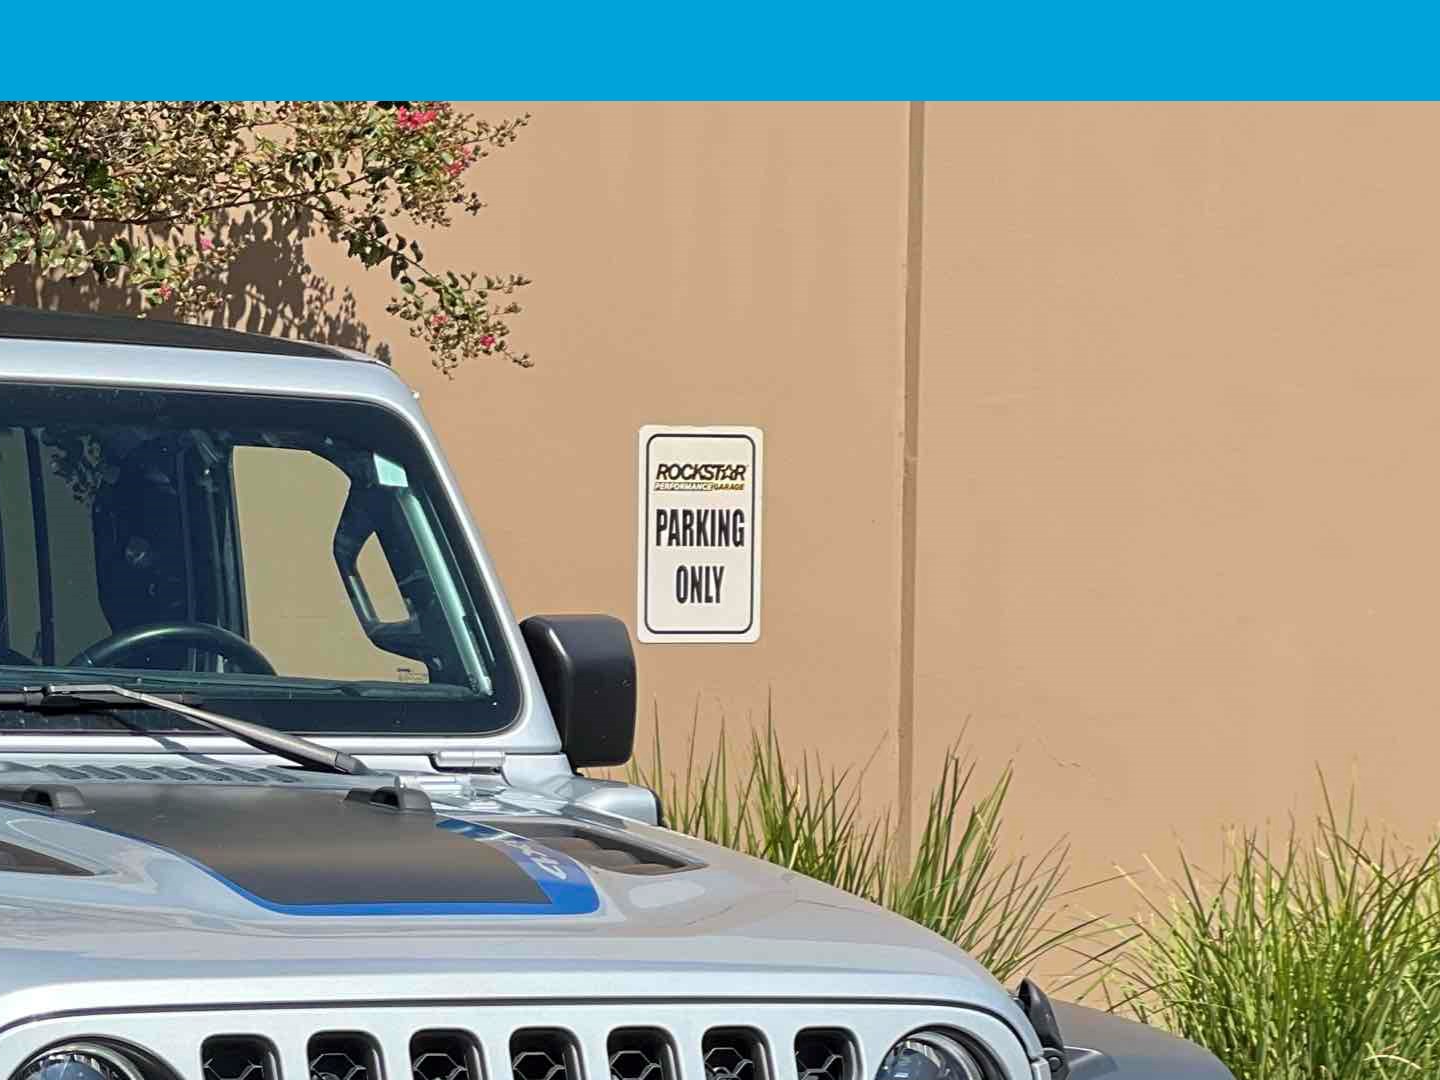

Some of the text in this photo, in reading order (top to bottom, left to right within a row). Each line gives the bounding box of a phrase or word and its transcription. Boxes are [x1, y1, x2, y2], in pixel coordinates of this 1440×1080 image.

[656, 463, 746, 481] ROCKSTAR
[656, 509, 745, 547] PARKING
[676, 565, 724, 604] ONLY
